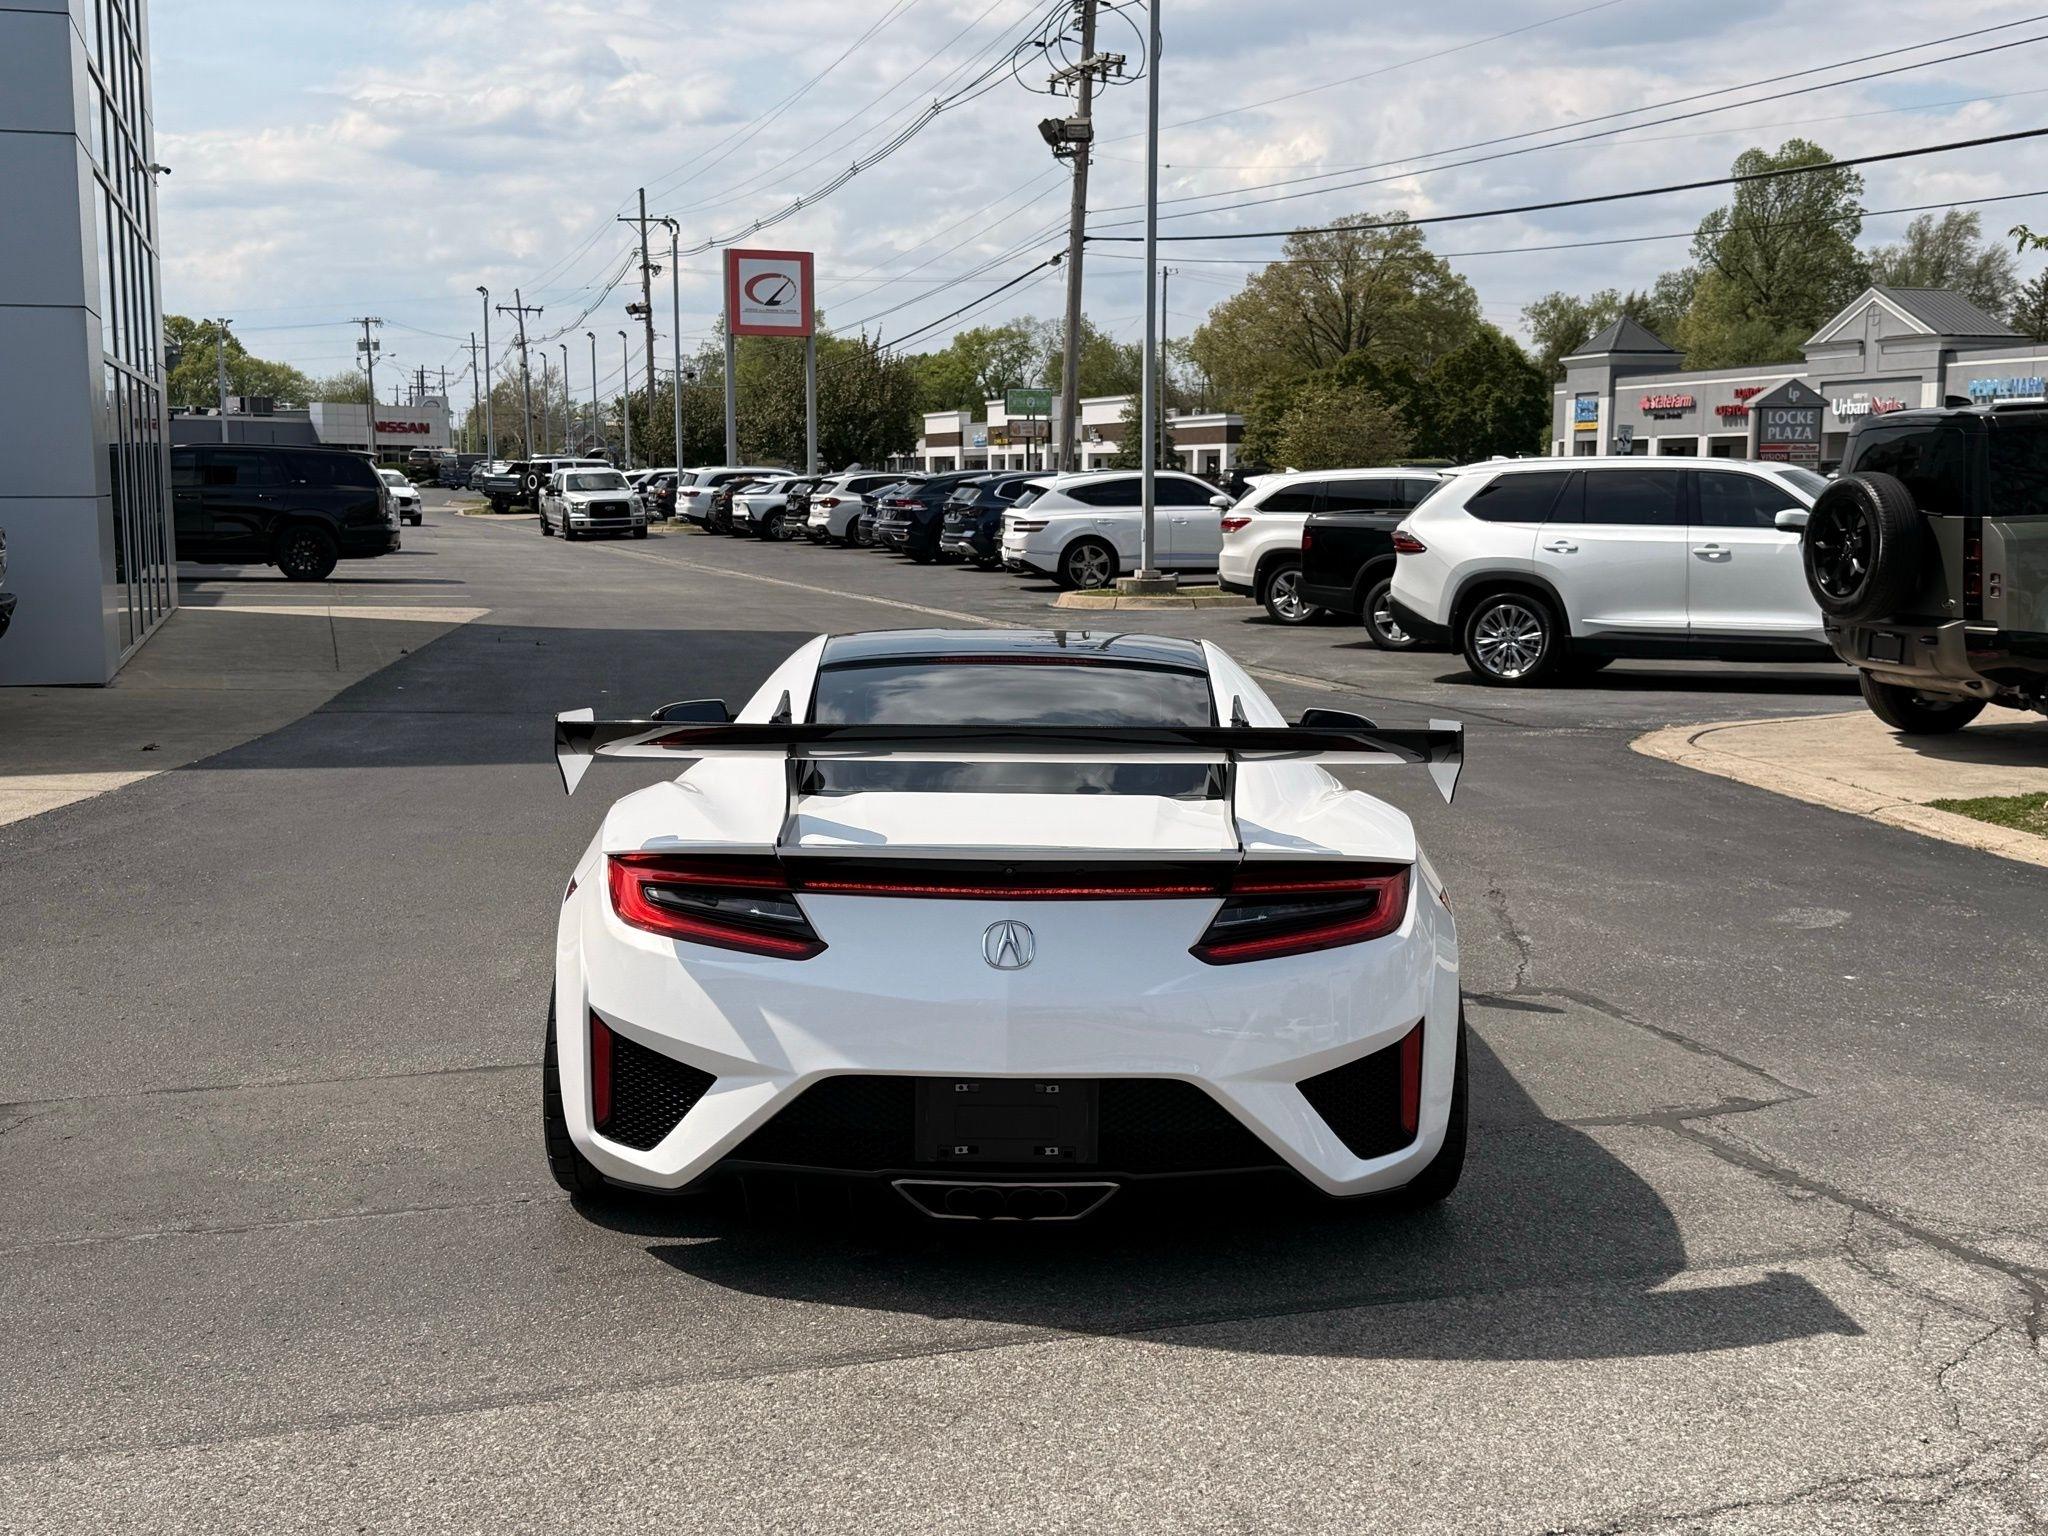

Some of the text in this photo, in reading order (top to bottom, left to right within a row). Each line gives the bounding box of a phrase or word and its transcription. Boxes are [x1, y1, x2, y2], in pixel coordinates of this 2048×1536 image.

[1832, 398, 1869, 415] Urban
[1768, 411, 1814, 425] LOCKE
[375, 421, 430, 434] NISSAN
[1767, 426, 1812, 440] PLAZA
[1761, 453, 1788, 461] VISION
